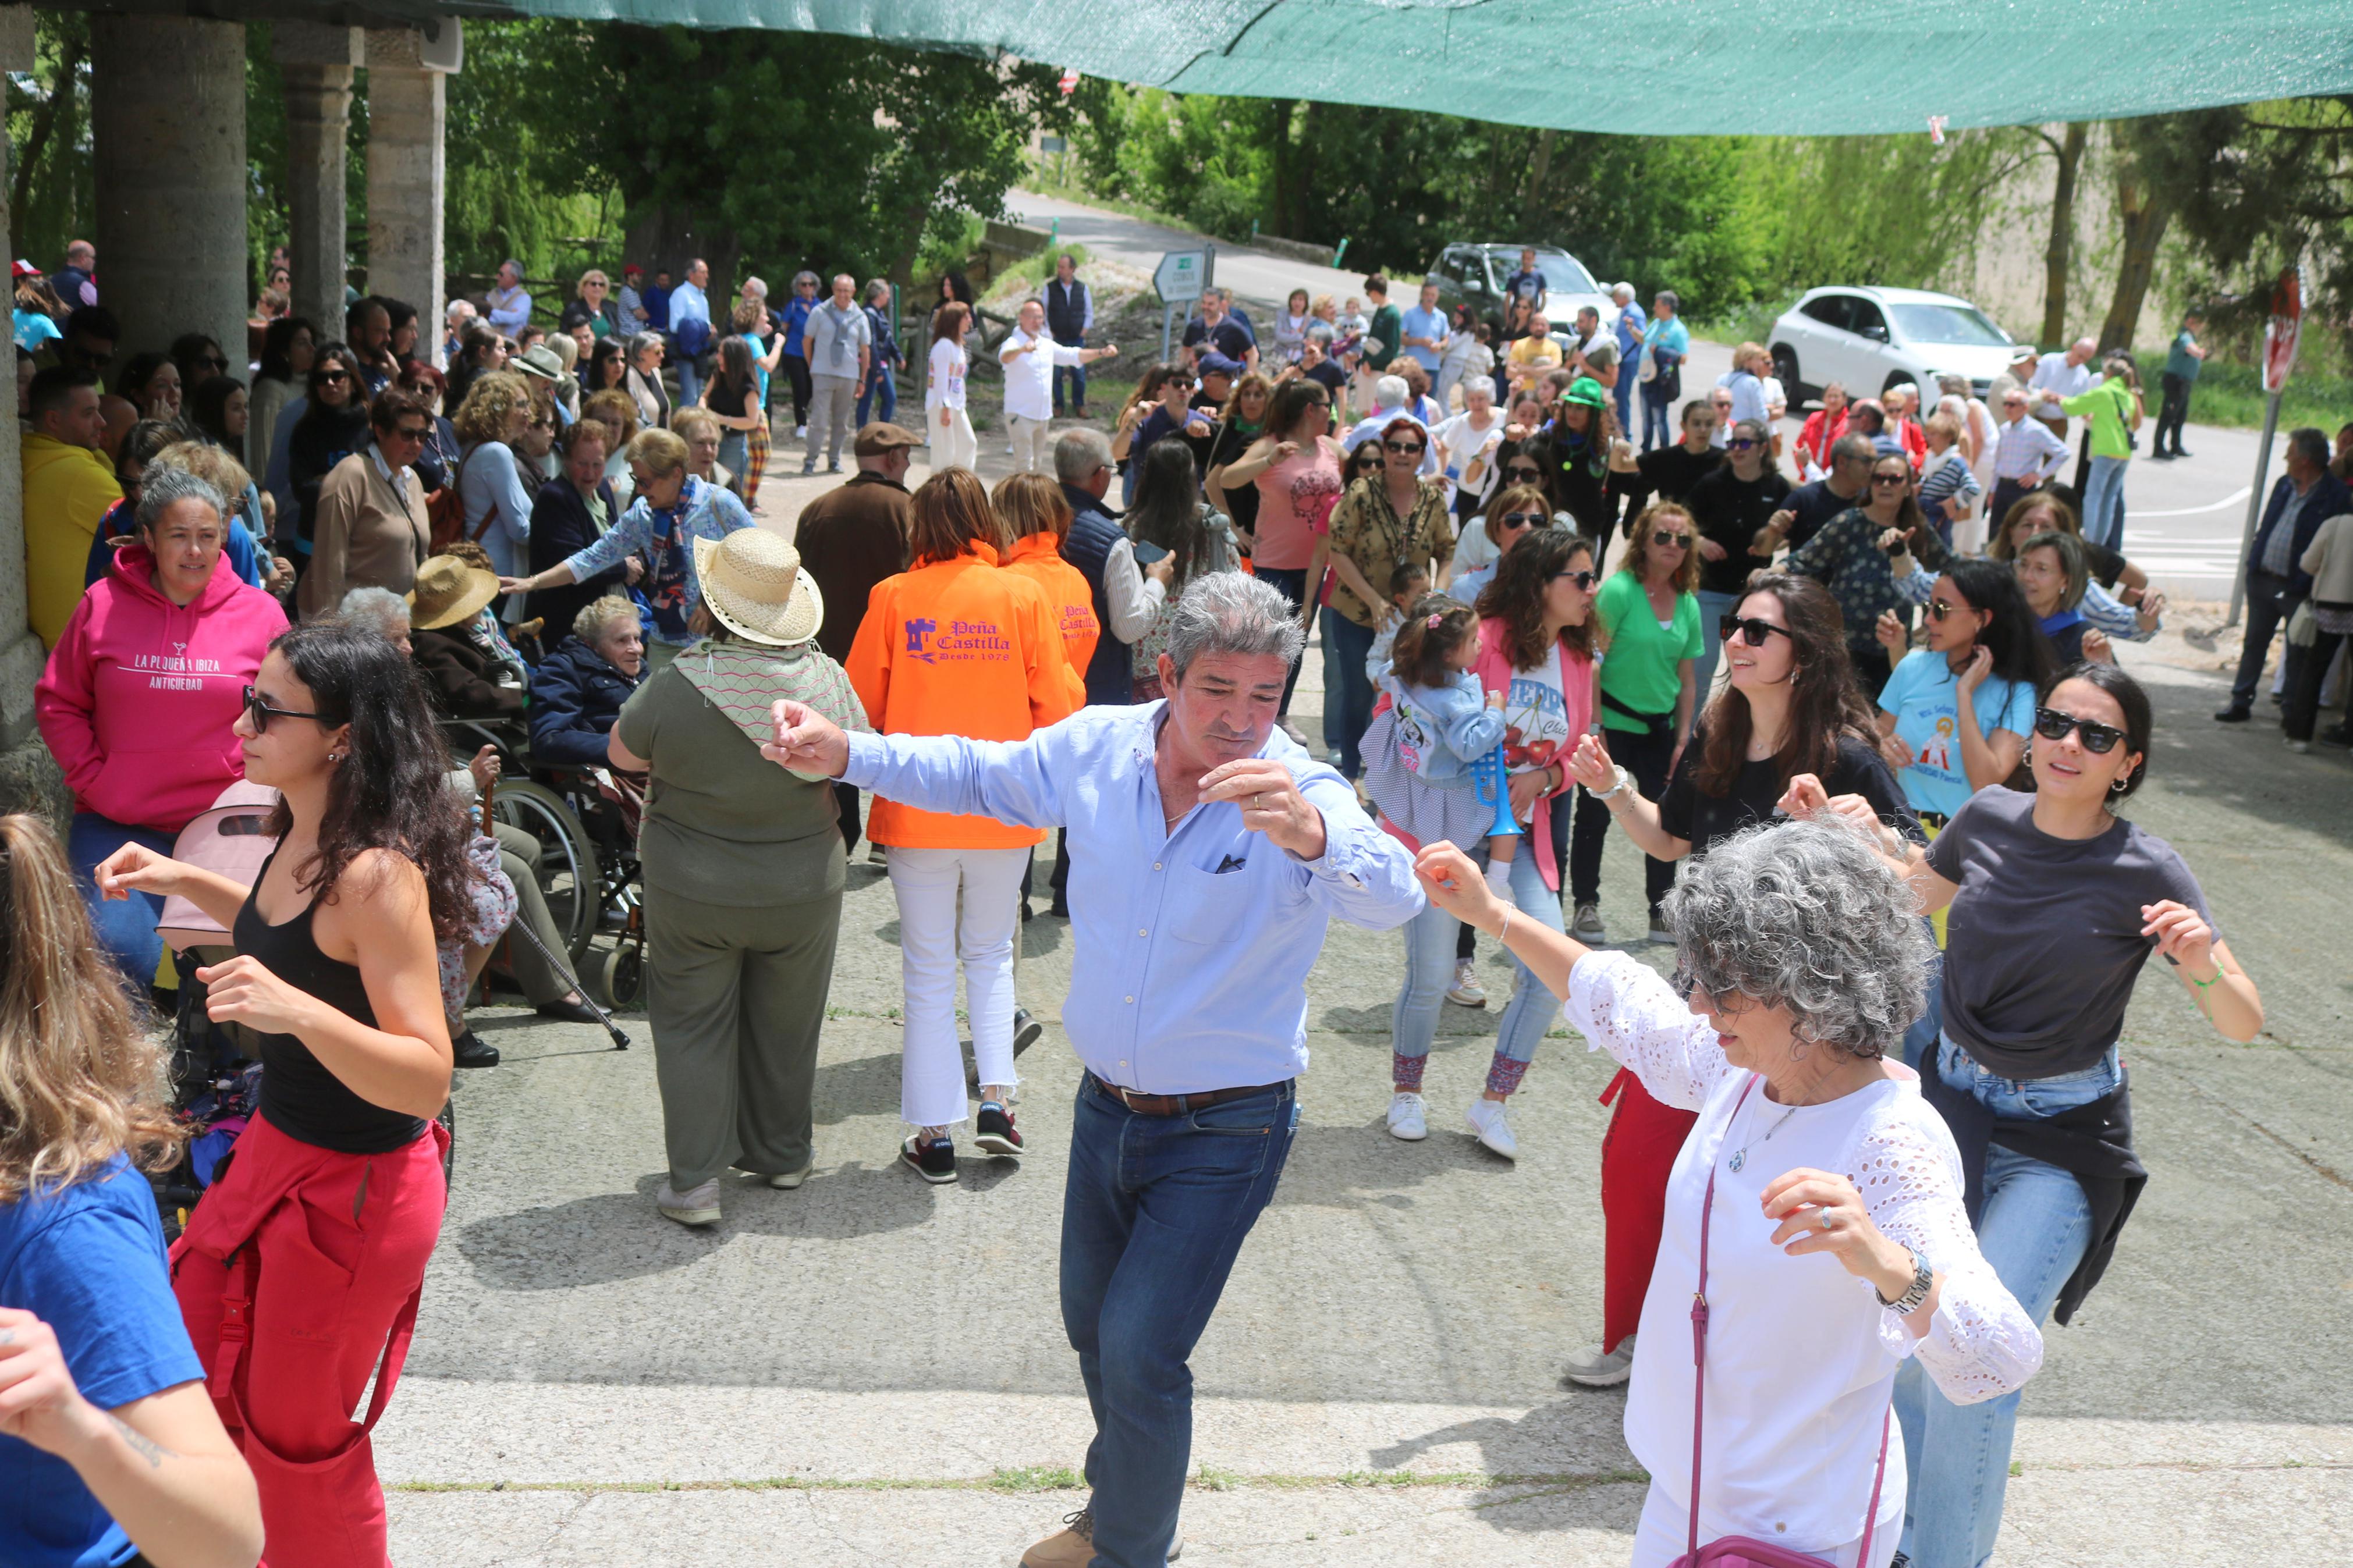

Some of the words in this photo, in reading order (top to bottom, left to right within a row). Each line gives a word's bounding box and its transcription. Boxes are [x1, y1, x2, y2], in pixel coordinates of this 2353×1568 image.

[1064, 605, 1089, 618] Peña
[950, 621, 997, 637] Peña
[1059, 617, 1095, 630] Castilla
[937, 637, 1010, 650] Castilla
[134, 654, 147, 668] LA
[196, 659, 220, 672] IBIZA
[982, 653, 1010, 661] 1978
[1543, 720, 1567, 735] Chic
